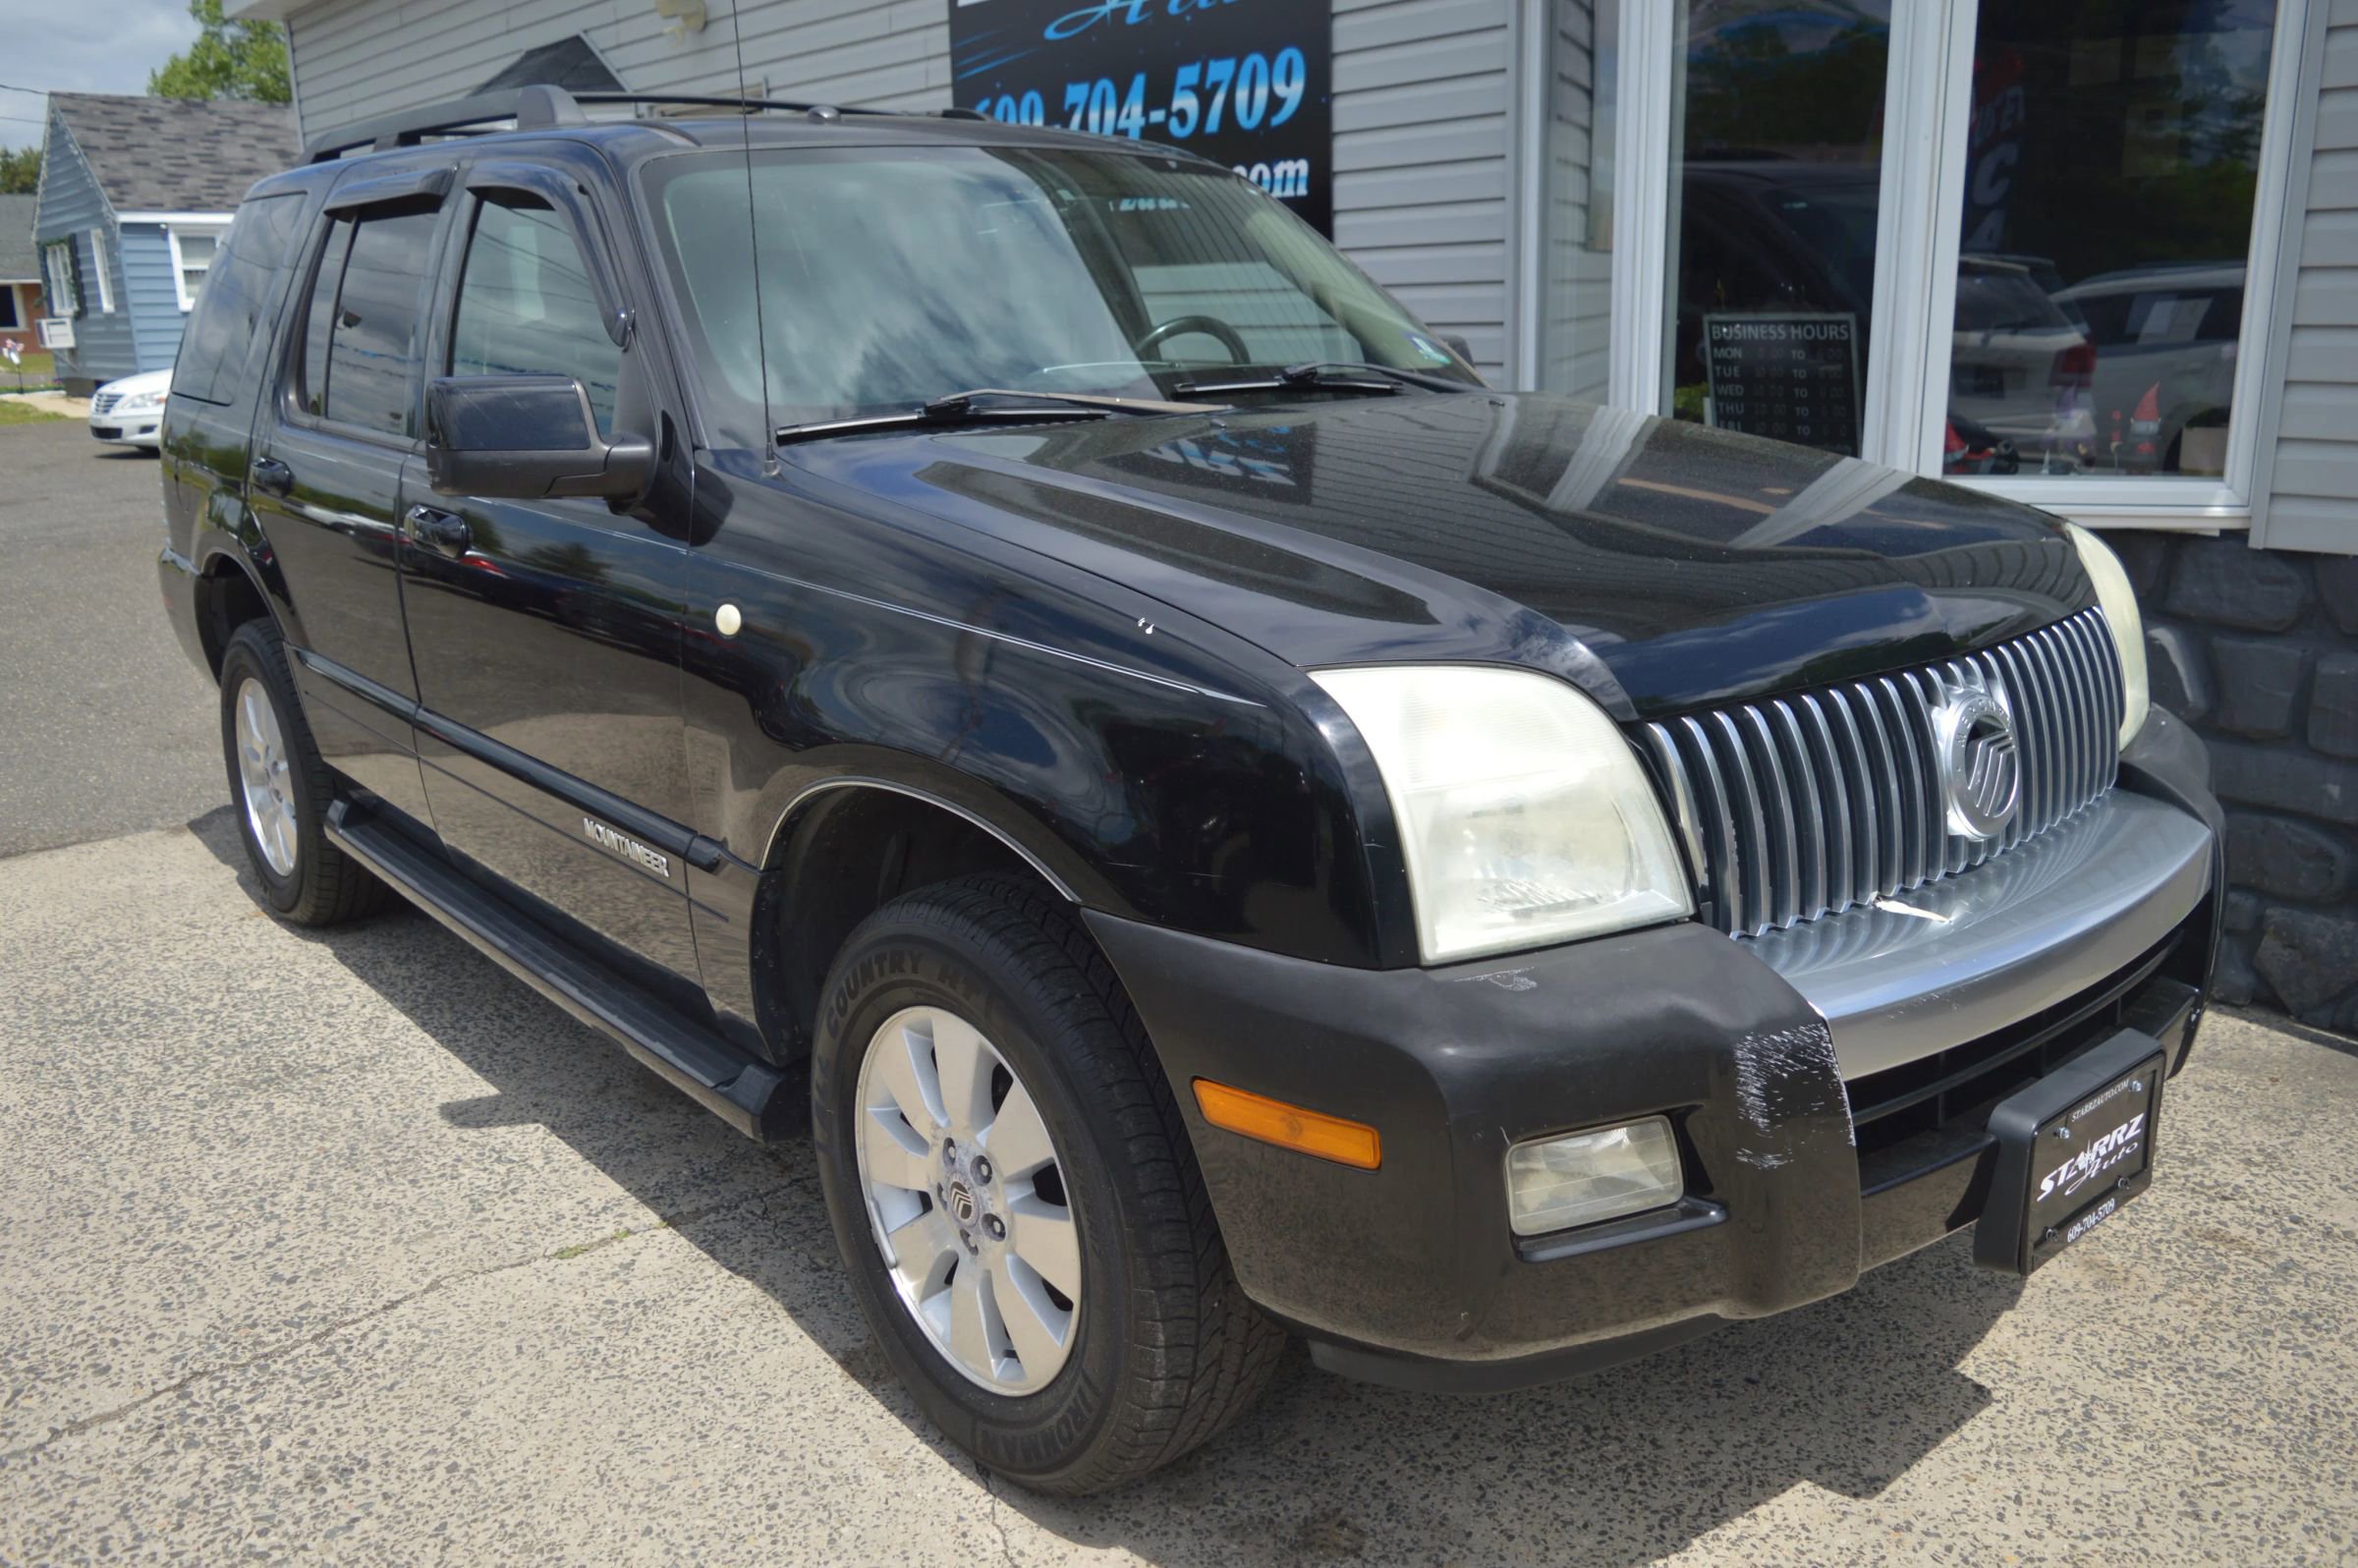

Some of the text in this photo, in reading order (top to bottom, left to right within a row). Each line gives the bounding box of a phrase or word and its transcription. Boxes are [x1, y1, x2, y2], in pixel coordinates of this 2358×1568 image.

[1712, 324, 1849, 341] BUSINESS HOURS
[1712, 346, 1743, 360] MON
[1791, 349, 1806, 361] TO
[1714, 365, 1742, 378] TUE
[1792, 368, 1808, 380] TO
[1715, 384, 1745, 398] WED
[1794, 387, 1809, 399] TO
[1717, 403, 1745, 415] THU
[1795, 407, 1810, 418] TO
[1796, 424, 1812, 436] TO
[583, 817, 670, 877] MOUNTAINEER
[825, 949, 924, 1039] COUNTRY
[2070, 1078, 2130, 1123] STARRZAUTO.COM
[2037, 1112, 2145, 1203] STARRZ
[2067, 1198, 2115, 1243] 609-704-5709
